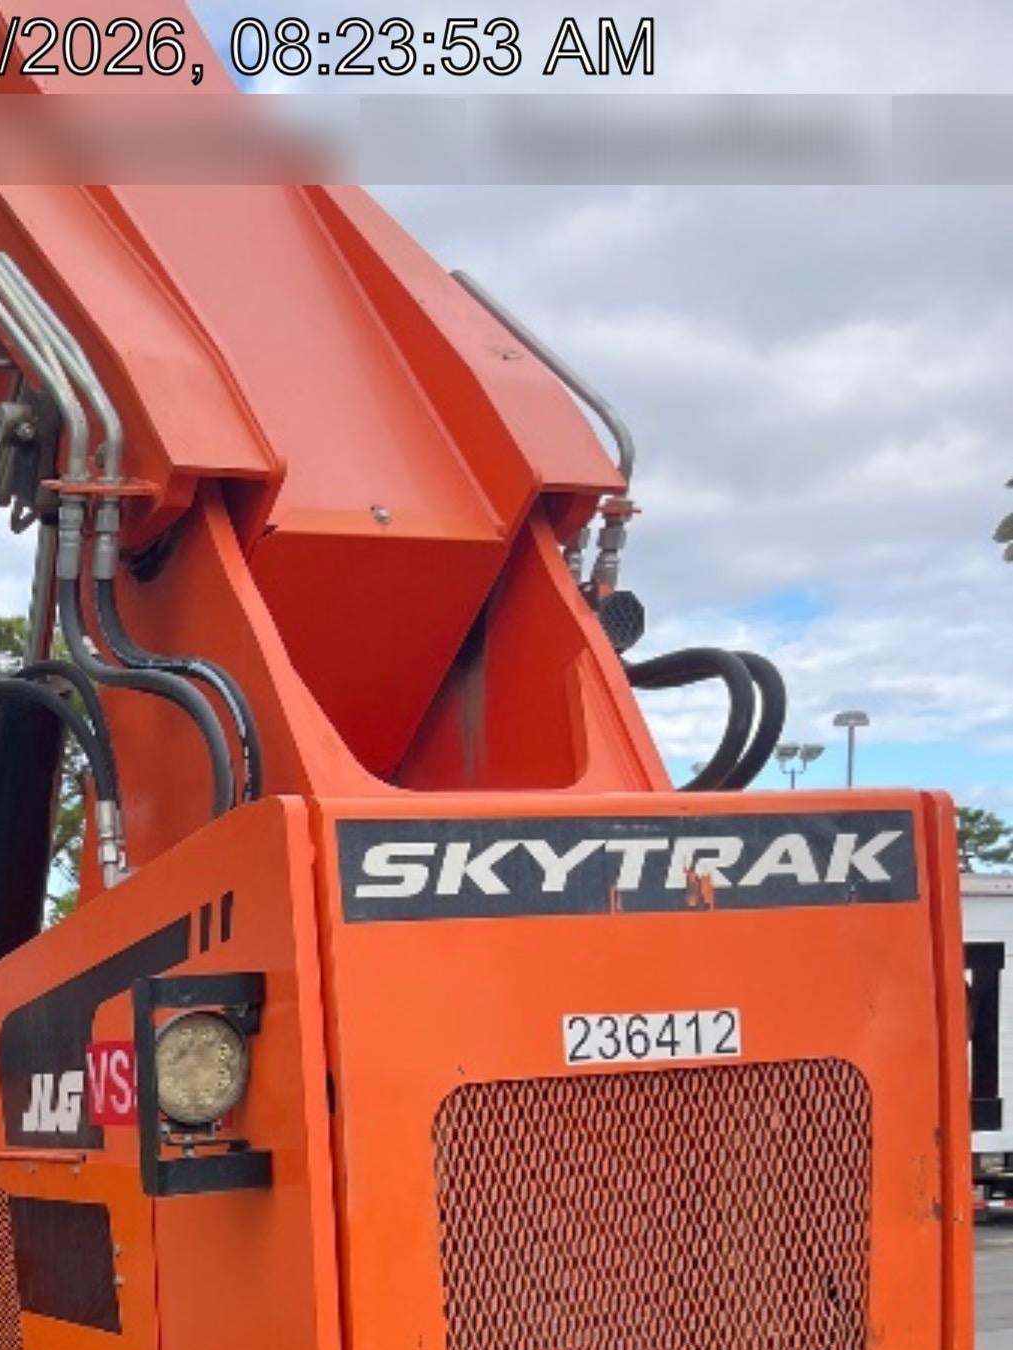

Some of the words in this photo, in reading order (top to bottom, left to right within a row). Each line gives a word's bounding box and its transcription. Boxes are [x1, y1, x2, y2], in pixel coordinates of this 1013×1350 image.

[355, 830, 904, 898] SKYTRAK
[567, 1010, 739, 1062] 236412
[22, 1071, 85, 1132] JLG
[86, 1049, 138, 1114] VS
